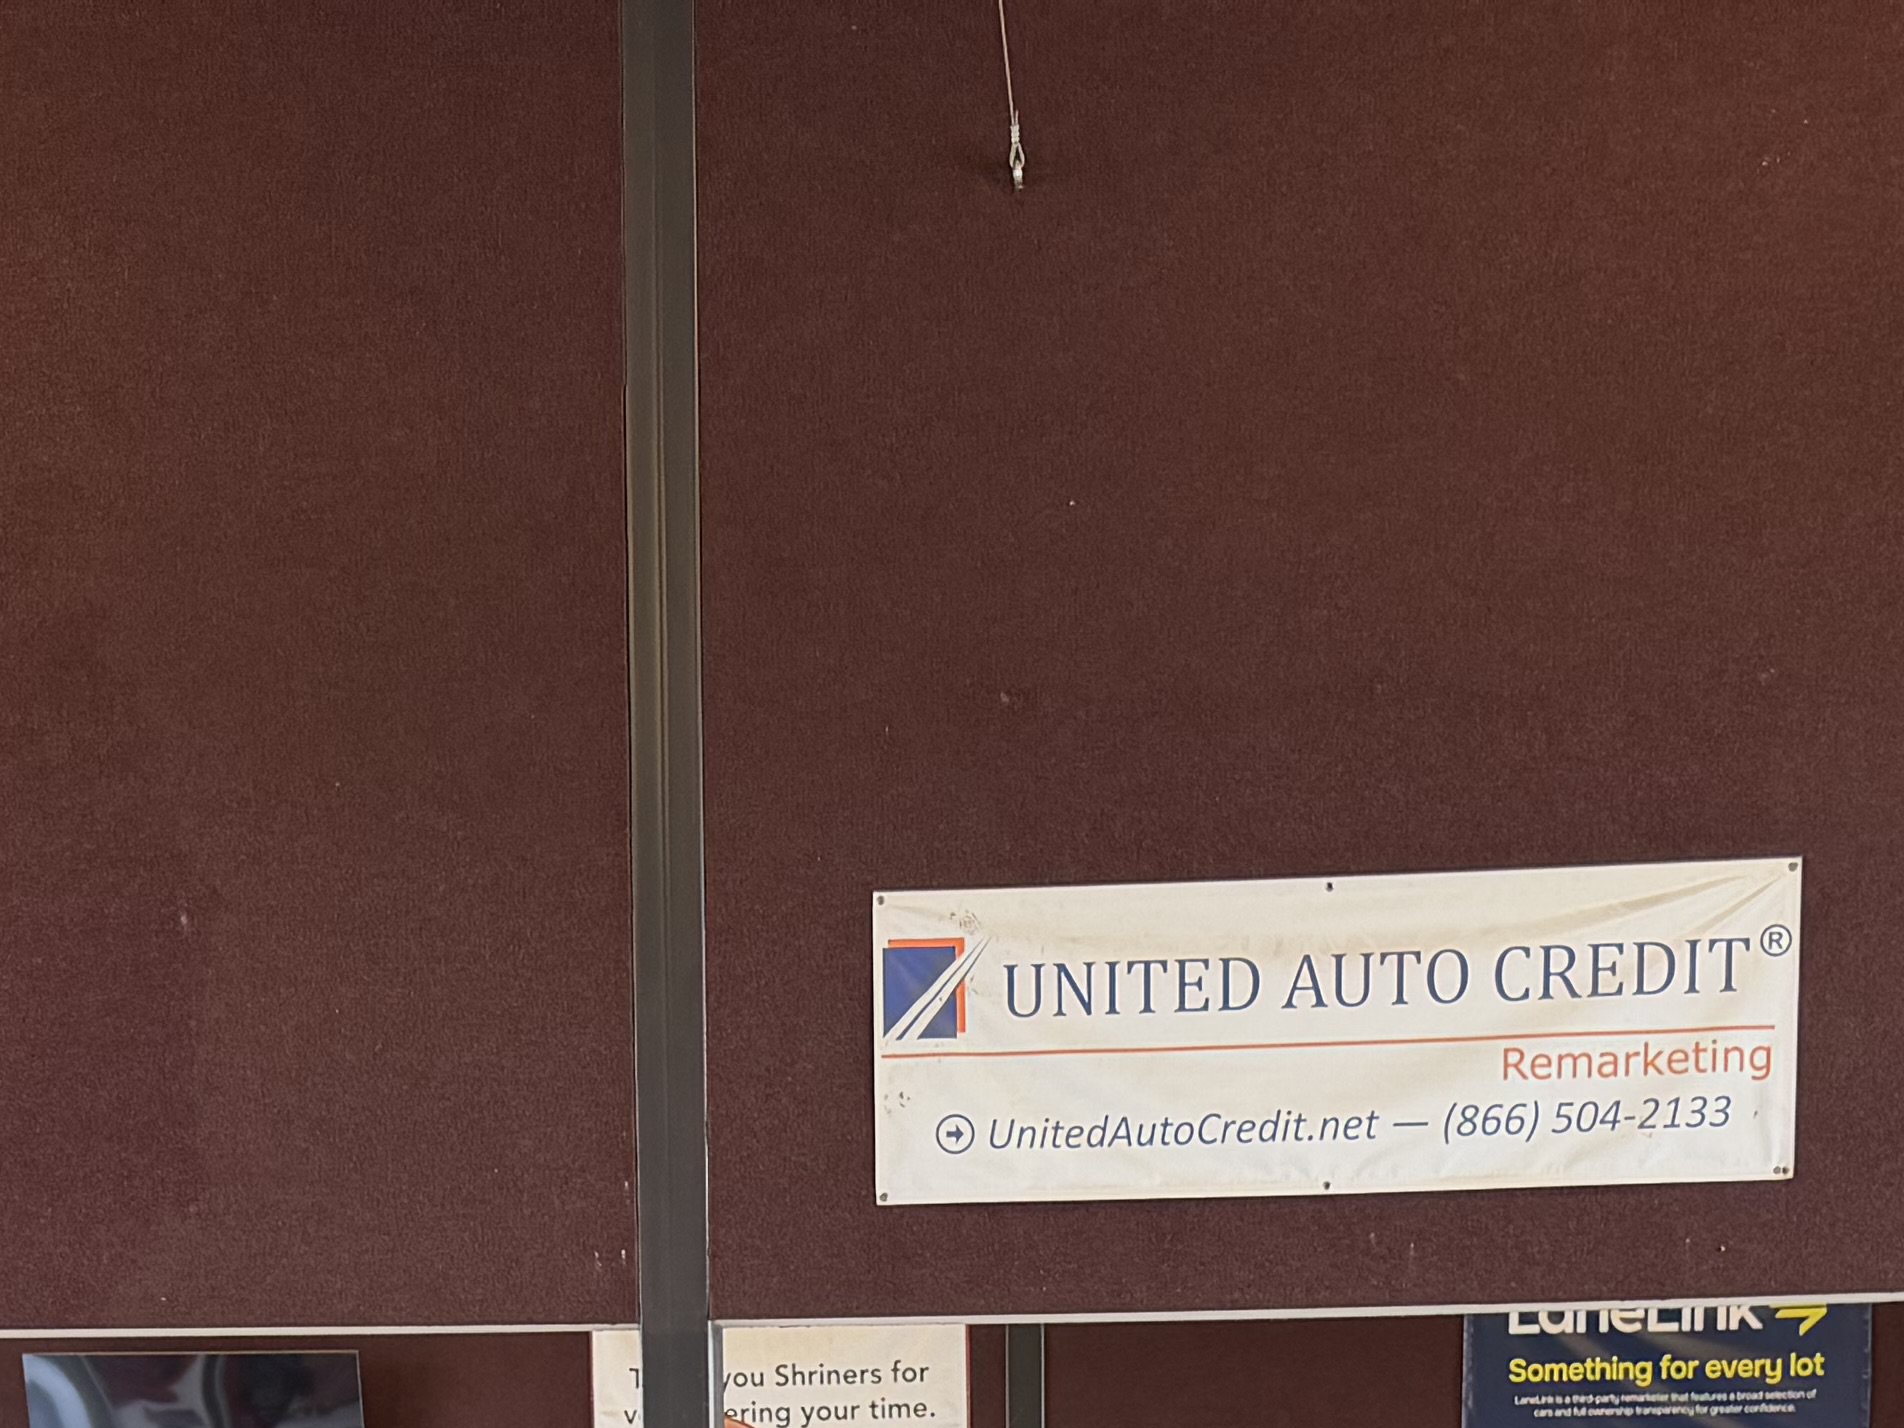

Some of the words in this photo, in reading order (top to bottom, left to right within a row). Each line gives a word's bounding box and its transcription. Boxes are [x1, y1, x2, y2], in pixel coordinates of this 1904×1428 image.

[1004, 955, 1261, 1019] UNITED
[1282, 947, 1470, 1012] AUTO
[1501, 1038, 1774, 1085] Remarketing
[987, 1107, 1379, 1152] UnitedAutoCredit.net
[1441, 1099, 1539, 1146] (866)
[1549, 1093, 1731, 1137] 504-2133
[774, 1362, 883, 1388] Shriners
[890, 1359, 930, 1384] for
[1508, 1354, 1654, 1388] Something
[1659, 1353, 1700, 1382] for
[1704, 1357, 1783, 1386] every
[1788, 1352, 1826, 1378] lot
[800, 1403, 862, 1428] your
[868, 1397, 937, 1421] time.
